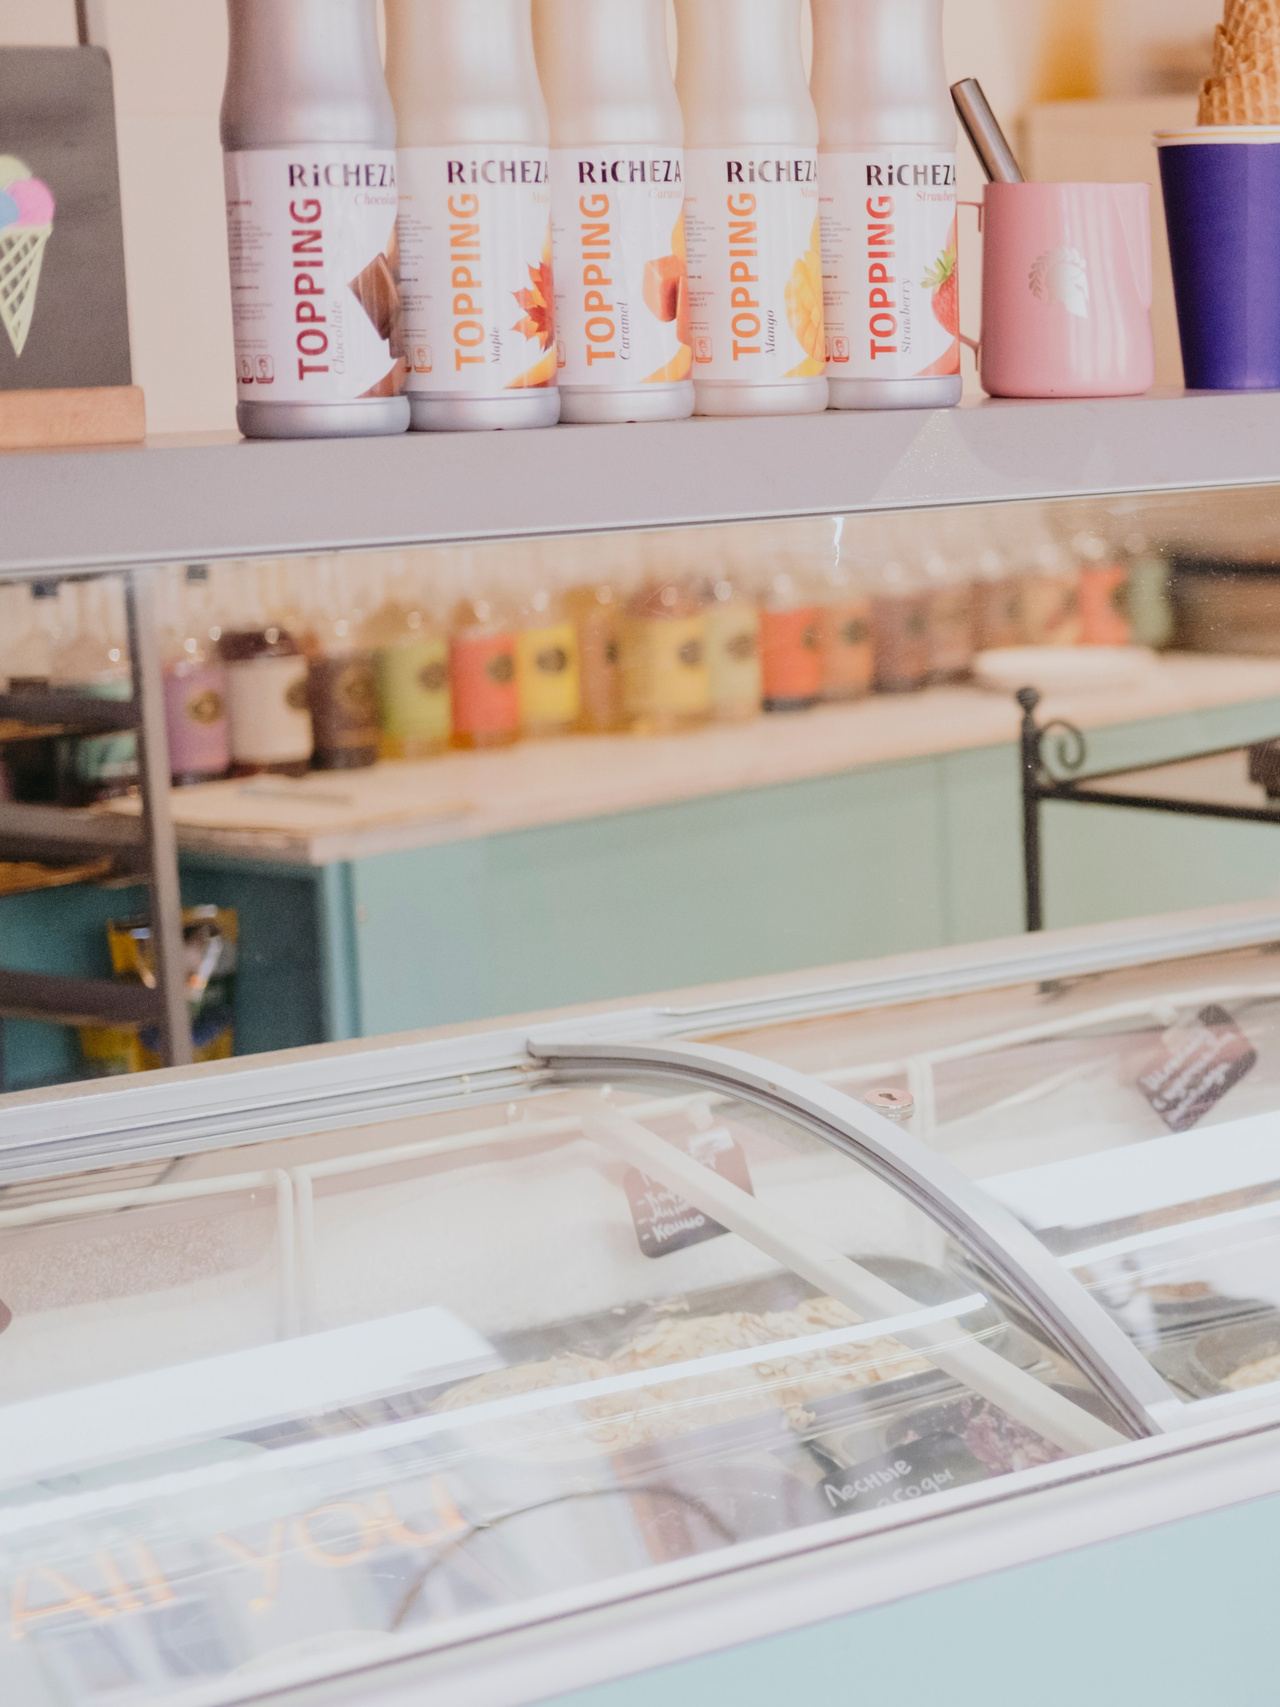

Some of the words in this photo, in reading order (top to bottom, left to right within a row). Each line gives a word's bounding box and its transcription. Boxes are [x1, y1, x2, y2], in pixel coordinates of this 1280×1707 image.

[289, 198, 329, 381] TOPPING
[447, 193, 486, 372] TOPPING
[579, 193, 616, 367] TOPPING
[727, 193, 761, 361] TOPPING
[866, 195, 898, 360] TOPPING
[330, 300, 345, 375] Chocolate
[489, 326, 503, 366] Maple
[616, 301, 631, 361] Caramel
[765, 309, 778, 357] Mango
[900, 278, 913, 354] Strawberry
[824, 1459, 912, 1507] Лесные
